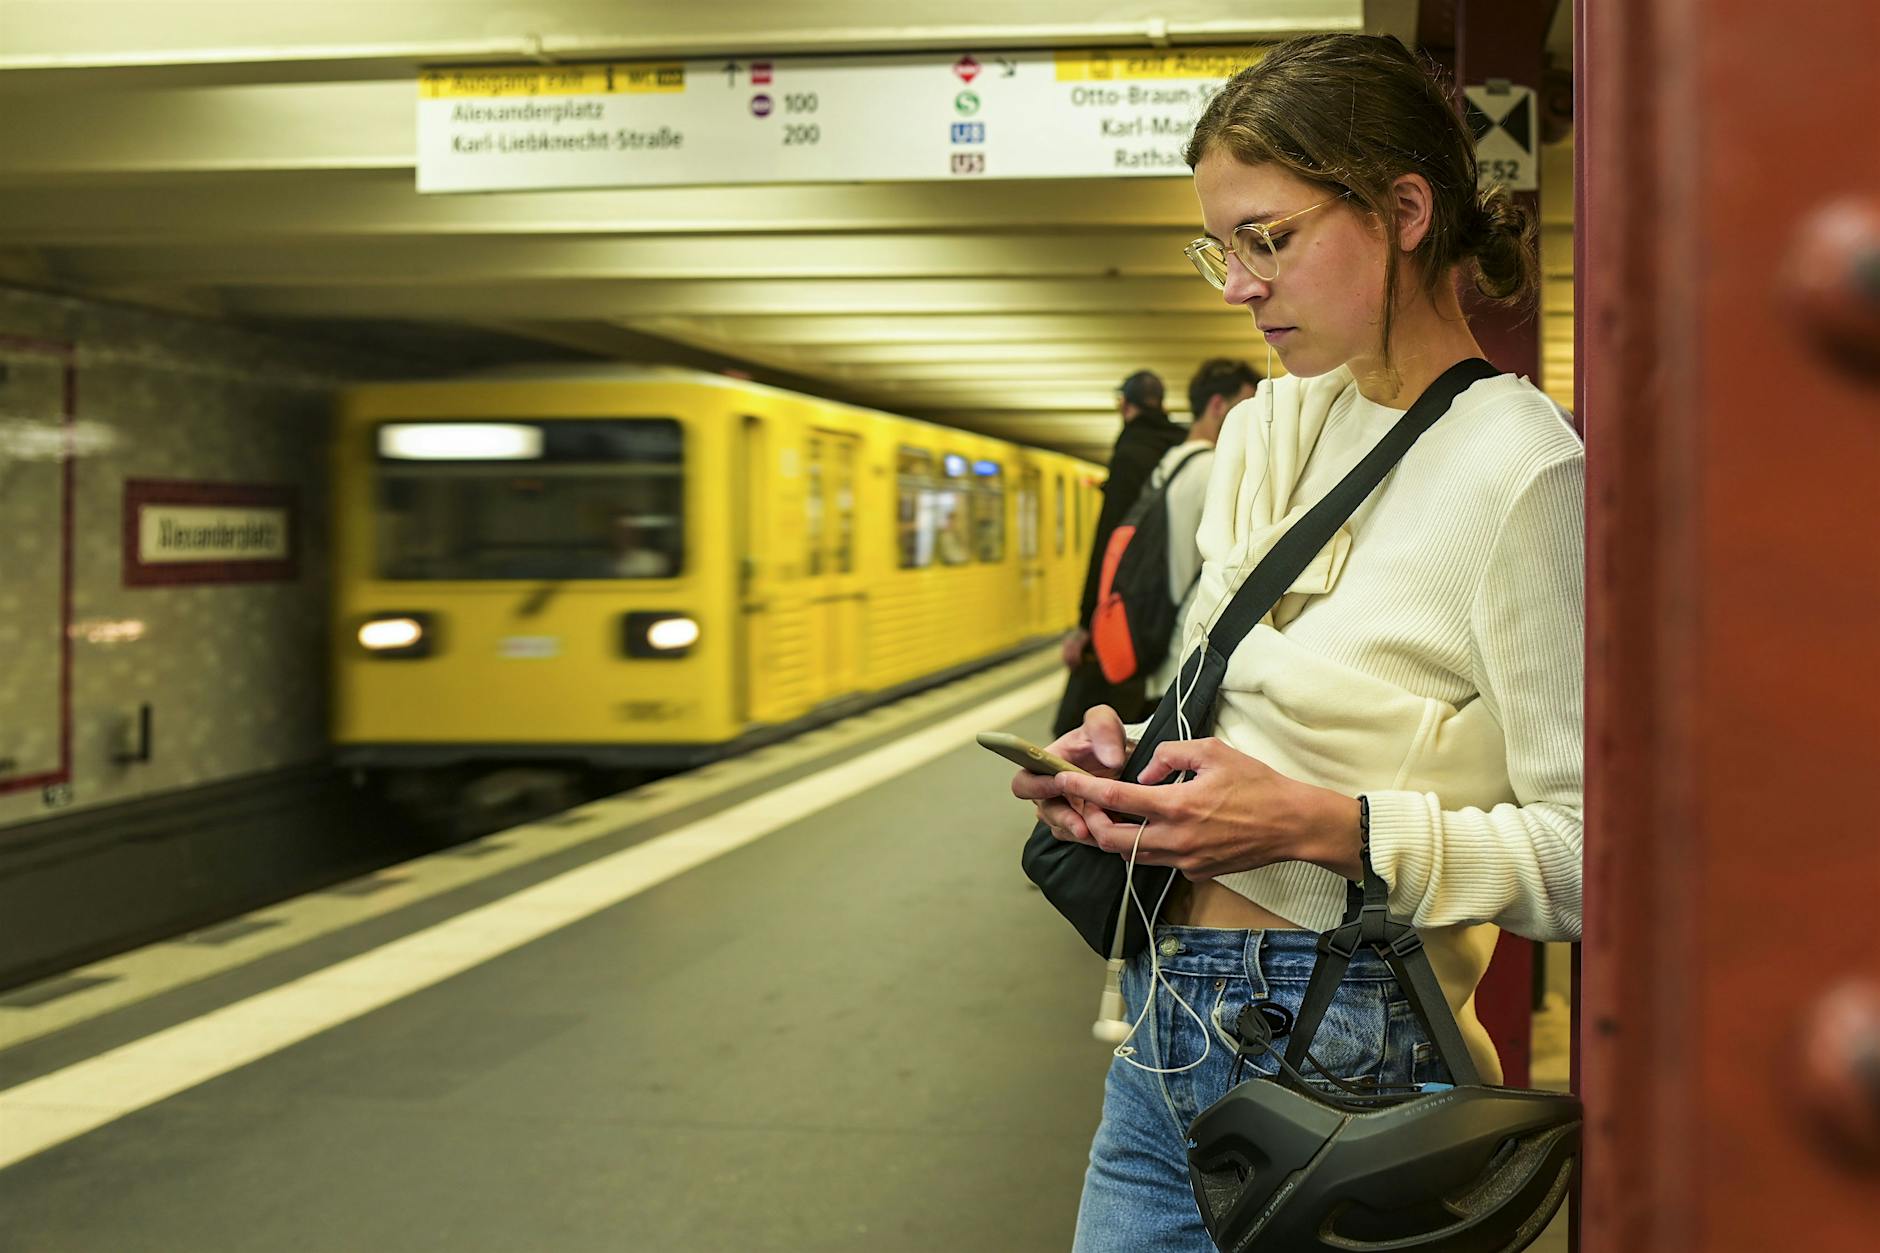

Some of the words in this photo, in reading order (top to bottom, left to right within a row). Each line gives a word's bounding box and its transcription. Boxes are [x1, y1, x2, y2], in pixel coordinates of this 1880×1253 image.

[452, 71, 539, 94] Ausgang
[452, 99, 605, 124] Alexanderplatz
[784, 93, 819, 113] 100
[452, 126, 684, 152] Karl-Liebknecht-Straße
[783, 123, 821, 145] 200
